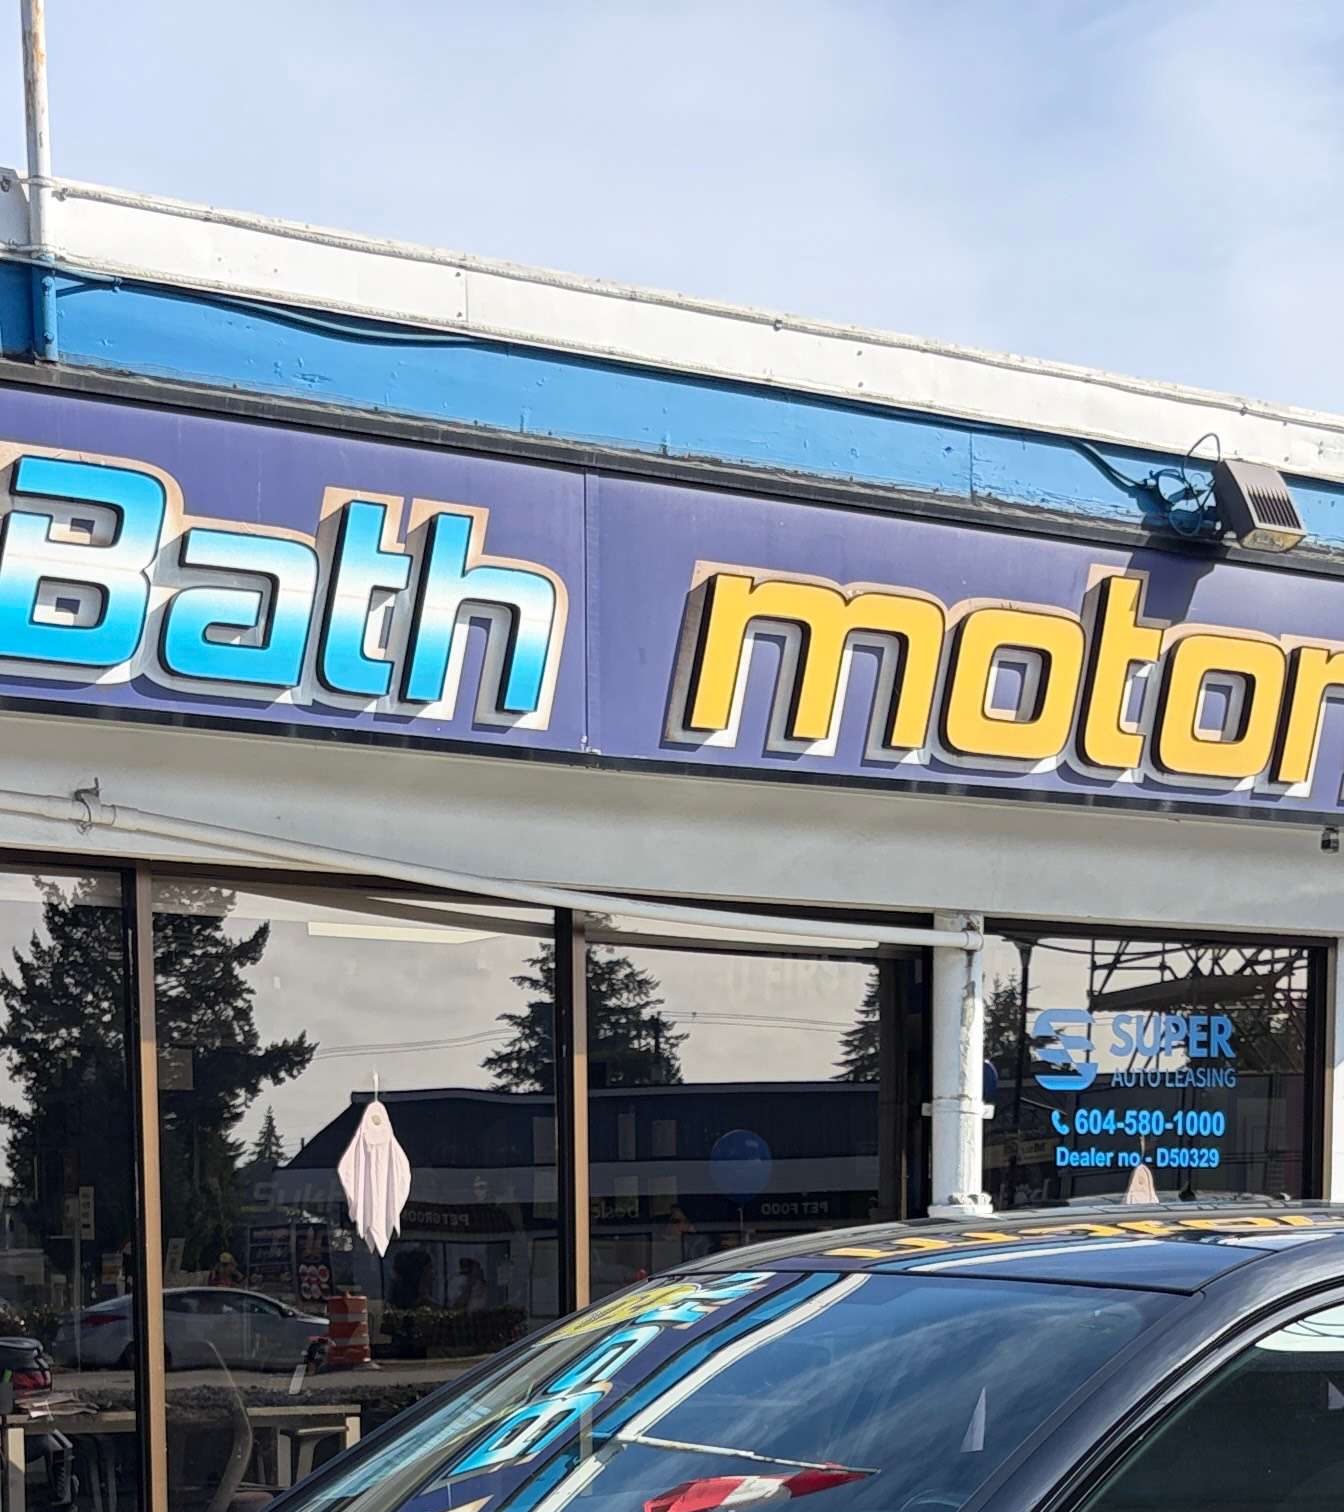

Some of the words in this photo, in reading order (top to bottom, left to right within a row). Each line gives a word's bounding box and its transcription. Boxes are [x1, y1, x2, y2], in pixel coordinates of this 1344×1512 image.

[1110, 1013, 1236, 1059] SUPER
[1111, 1067, 1161, 1088] AUTO
[1165, 1066, 1236, 1089] LEASING
[1075, 1108, 1226, 1136] 604-580-1000
[1056, 1146, 1113, 1168] Dealer
[1118, 1150, 1141, 1168] no
[1156, 1147, 1220, 1168] D50329
